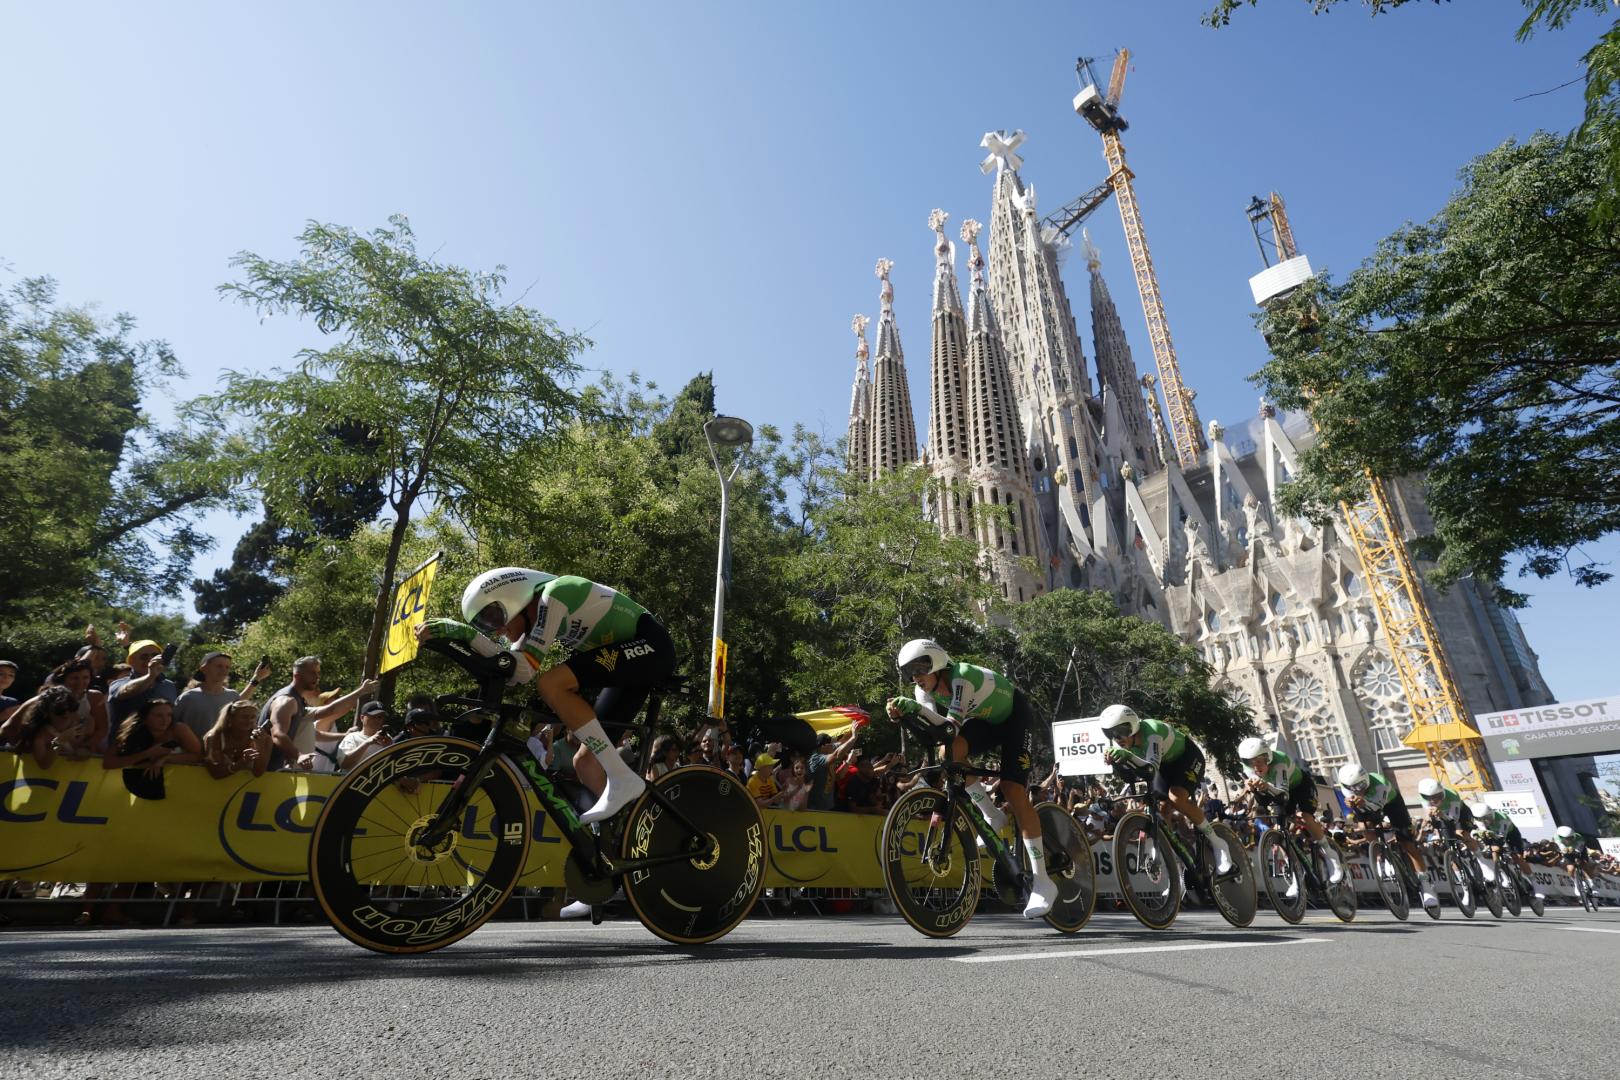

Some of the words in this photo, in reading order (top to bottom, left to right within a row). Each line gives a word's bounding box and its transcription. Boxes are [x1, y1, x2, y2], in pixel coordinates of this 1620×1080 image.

[393, 583, 424, 626] LCL
[623, 643, 655, 660] RGA
[1519, 702, 1608, 724] TISSOT
[1059, 743, 1105, 756] TISSOT
[0, 777, 108, 825] CL
[773, 824, 838, 853] LCL
